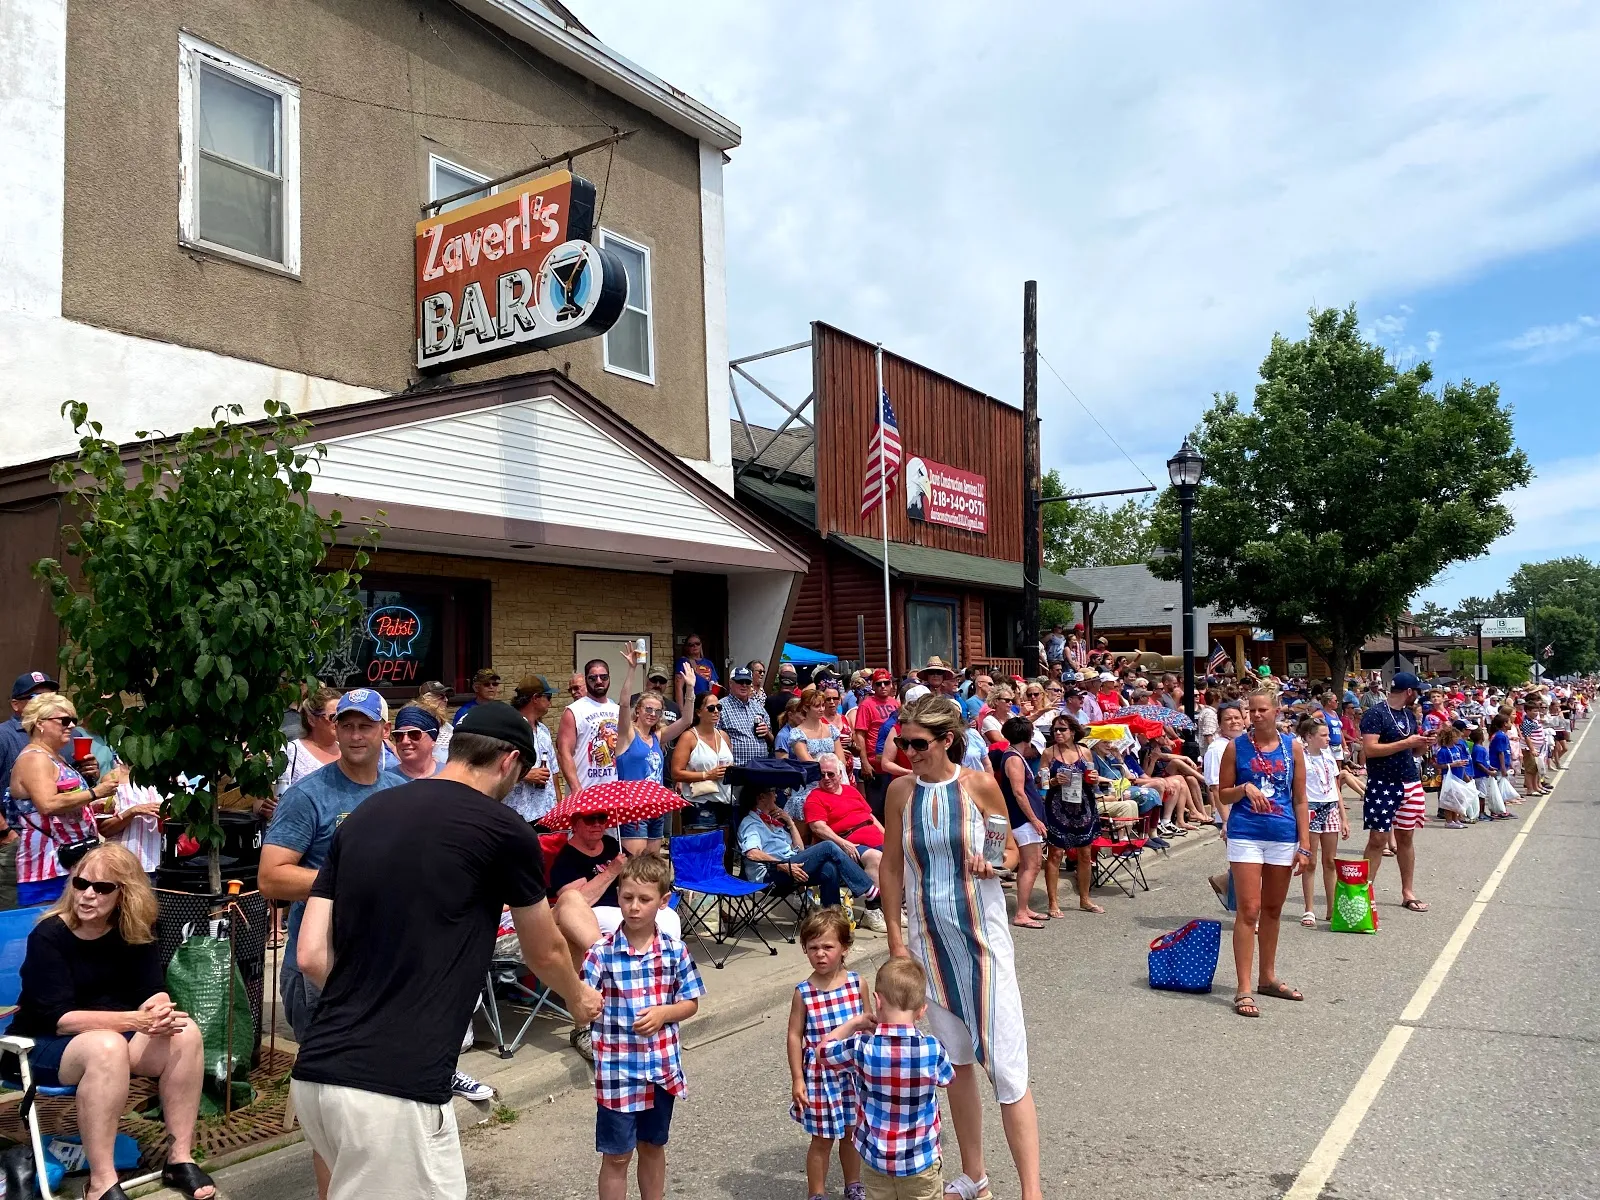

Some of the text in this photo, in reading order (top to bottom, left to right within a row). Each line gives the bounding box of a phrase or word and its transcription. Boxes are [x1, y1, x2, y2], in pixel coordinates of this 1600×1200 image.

[422, 192, 560, 282] Zaverl's
[420, 268, 536, 359] BAR
[376, 615, 416, 637] Pabst
[367, 659, 418, 682] OPEN
[587, 768, 611, 778] GREAT
